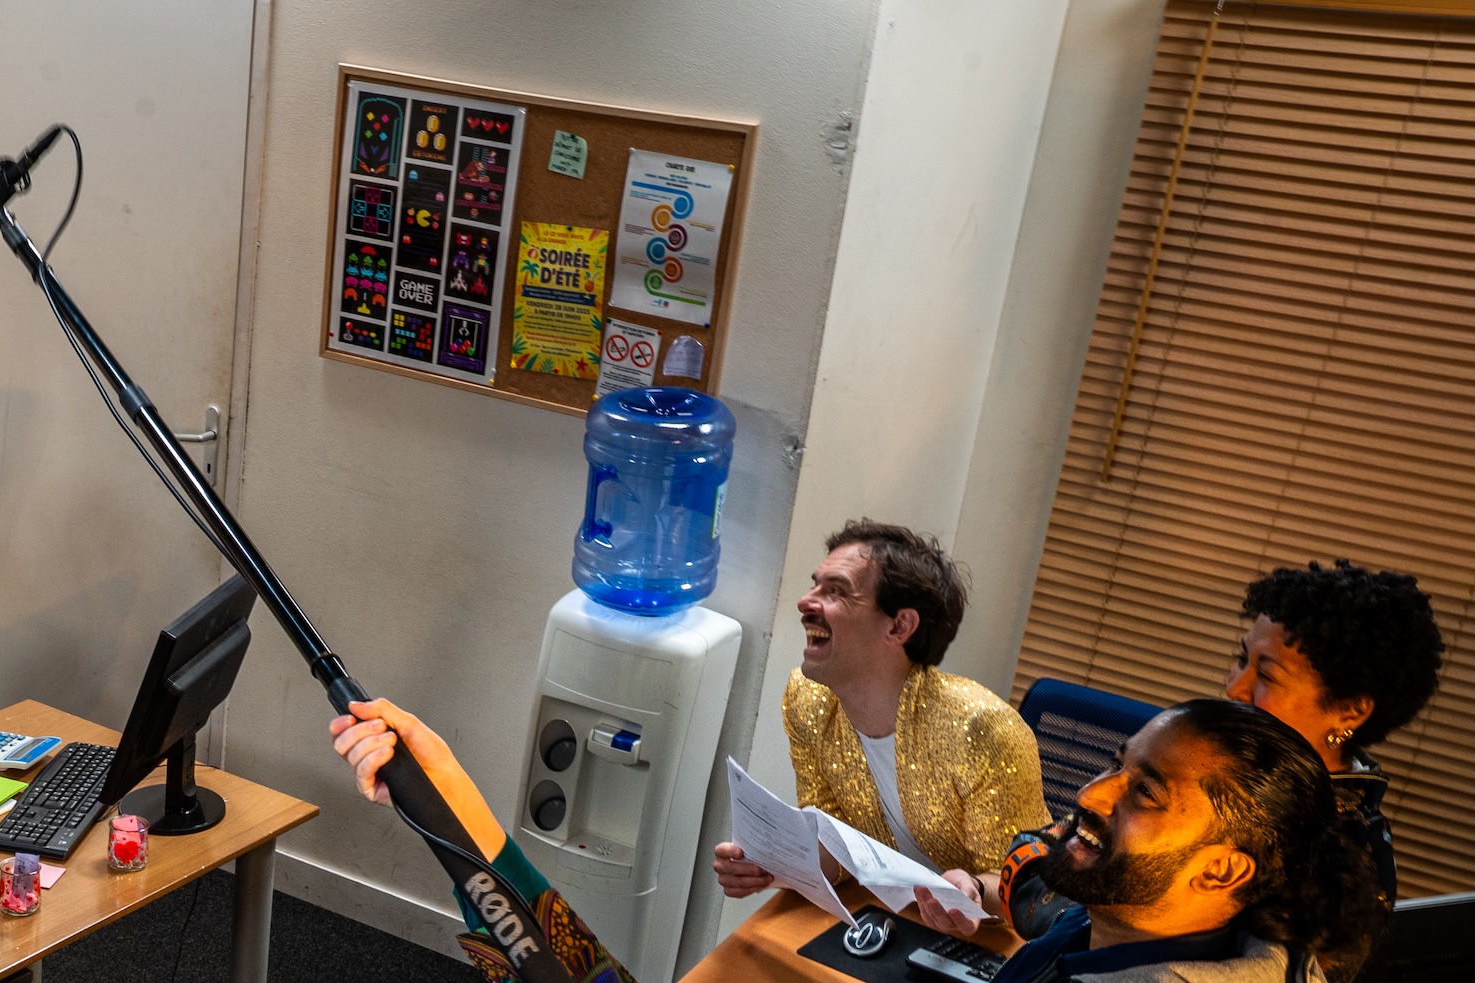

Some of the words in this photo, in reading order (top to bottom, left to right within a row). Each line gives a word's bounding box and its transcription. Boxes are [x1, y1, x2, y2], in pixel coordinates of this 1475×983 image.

[539, 247, 590, 269] SOIRÉE
[540, 266, 580, 288] D'ÉTÉ
[400, 279, 434, 296] GAME
[398, 289, 434, 305] OVER
[526, 301, 553, 309] VENDREDI
